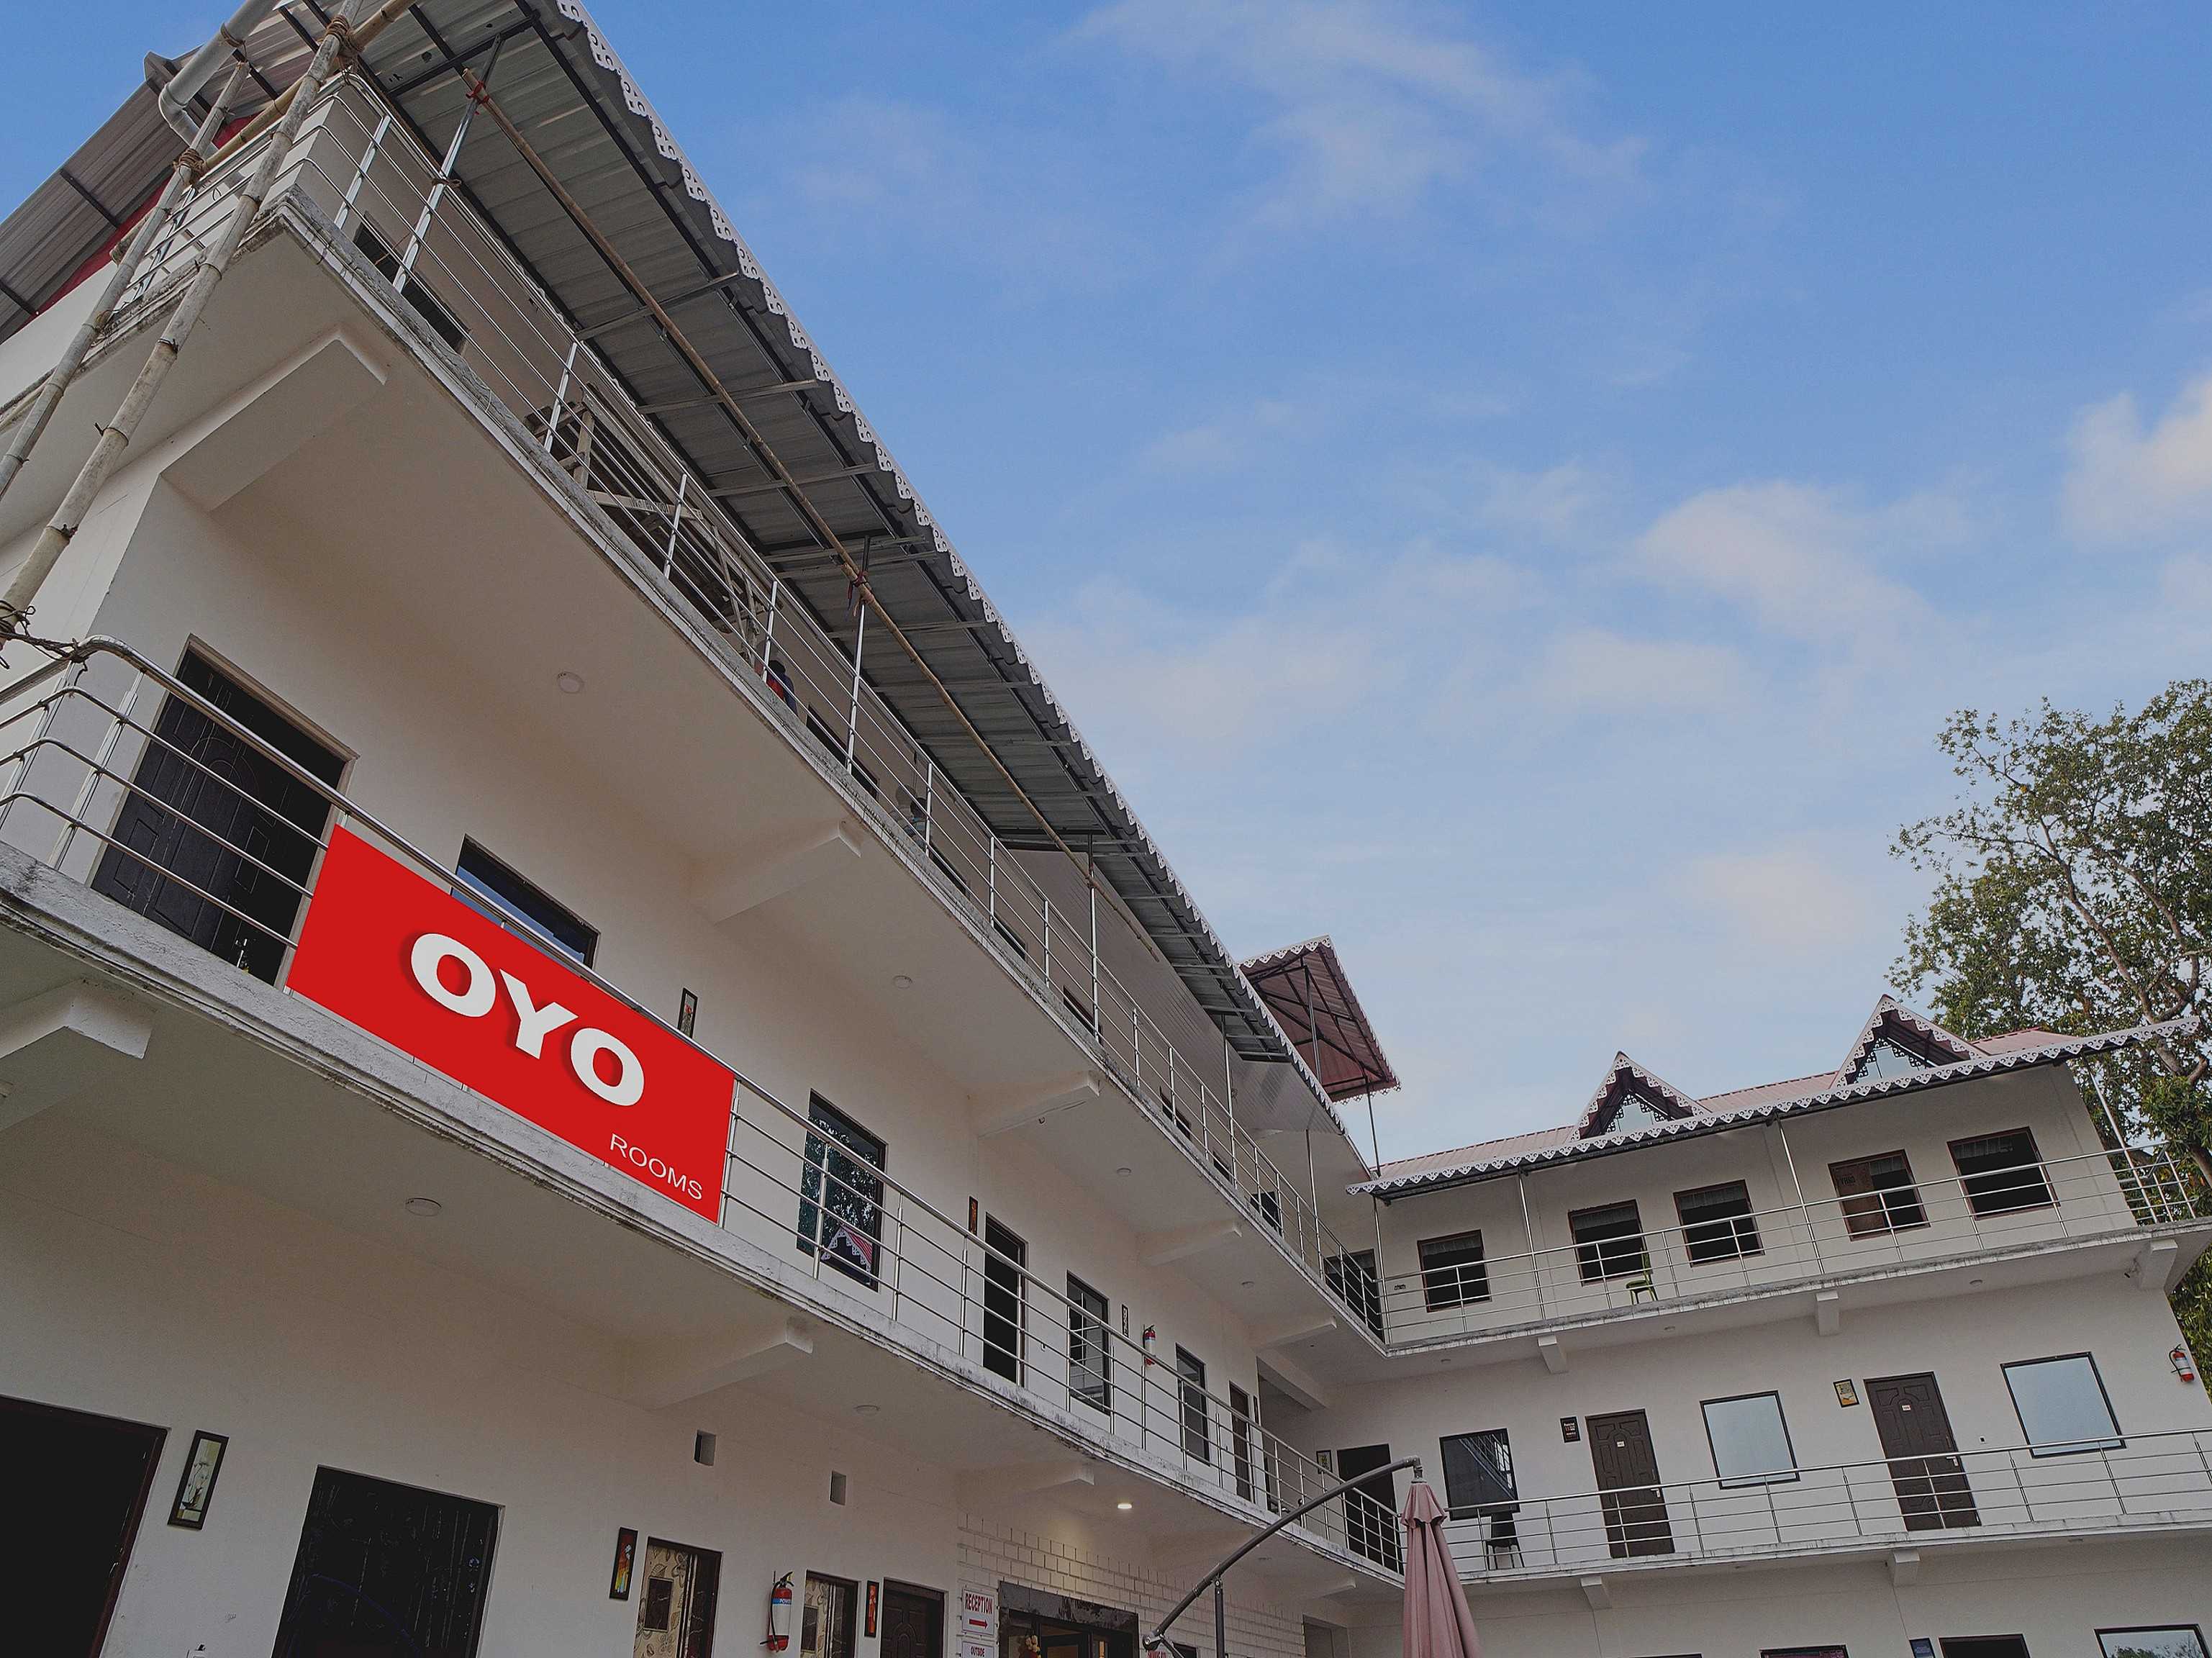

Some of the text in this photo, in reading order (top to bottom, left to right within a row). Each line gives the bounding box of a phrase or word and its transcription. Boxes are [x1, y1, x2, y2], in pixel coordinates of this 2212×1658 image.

[411, 933, 645, 1106] OYO
[609, 1133, 703, 1200] ROOMS
[964, 1592, 993, 1615] RECEPTION
